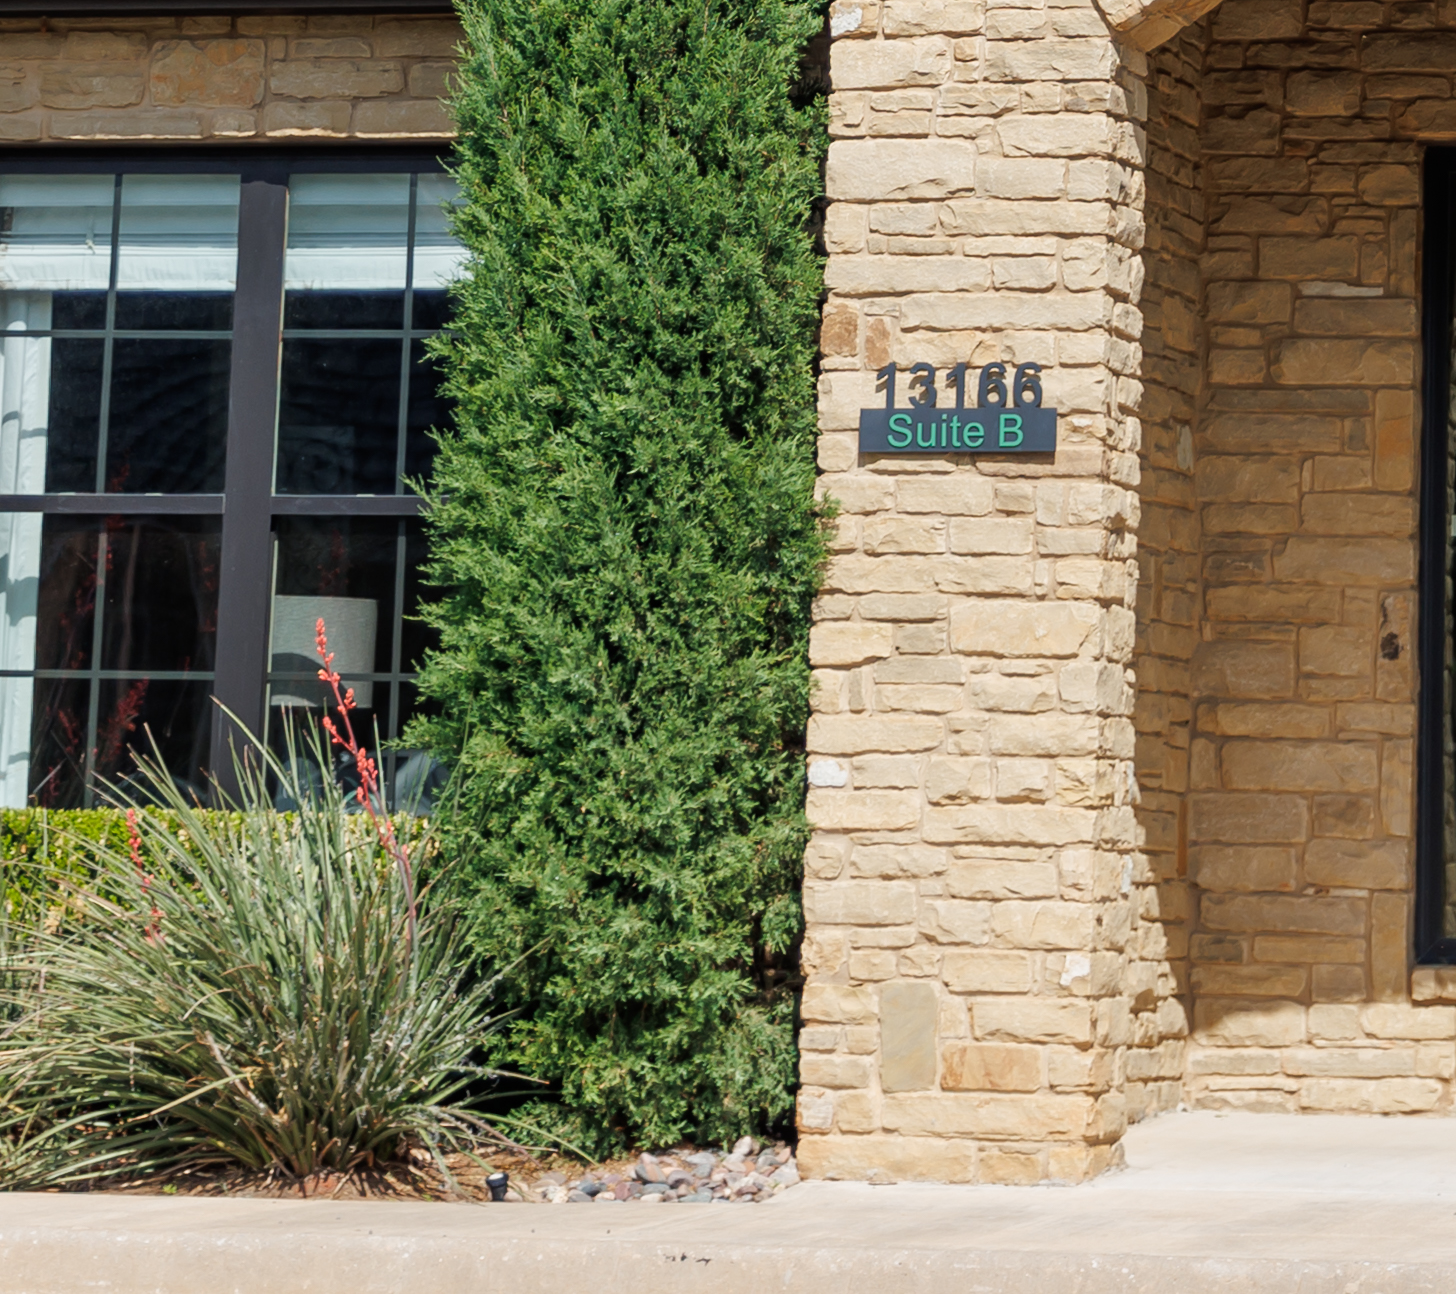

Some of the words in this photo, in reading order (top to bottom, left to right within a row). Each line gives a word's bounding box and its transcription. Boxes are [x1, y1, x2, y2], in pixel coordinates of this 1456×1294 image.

[876, 361, 1043, 410] 13166
[887, 413, 985, 448] Suite
[998, 413, 1025, 448] B
